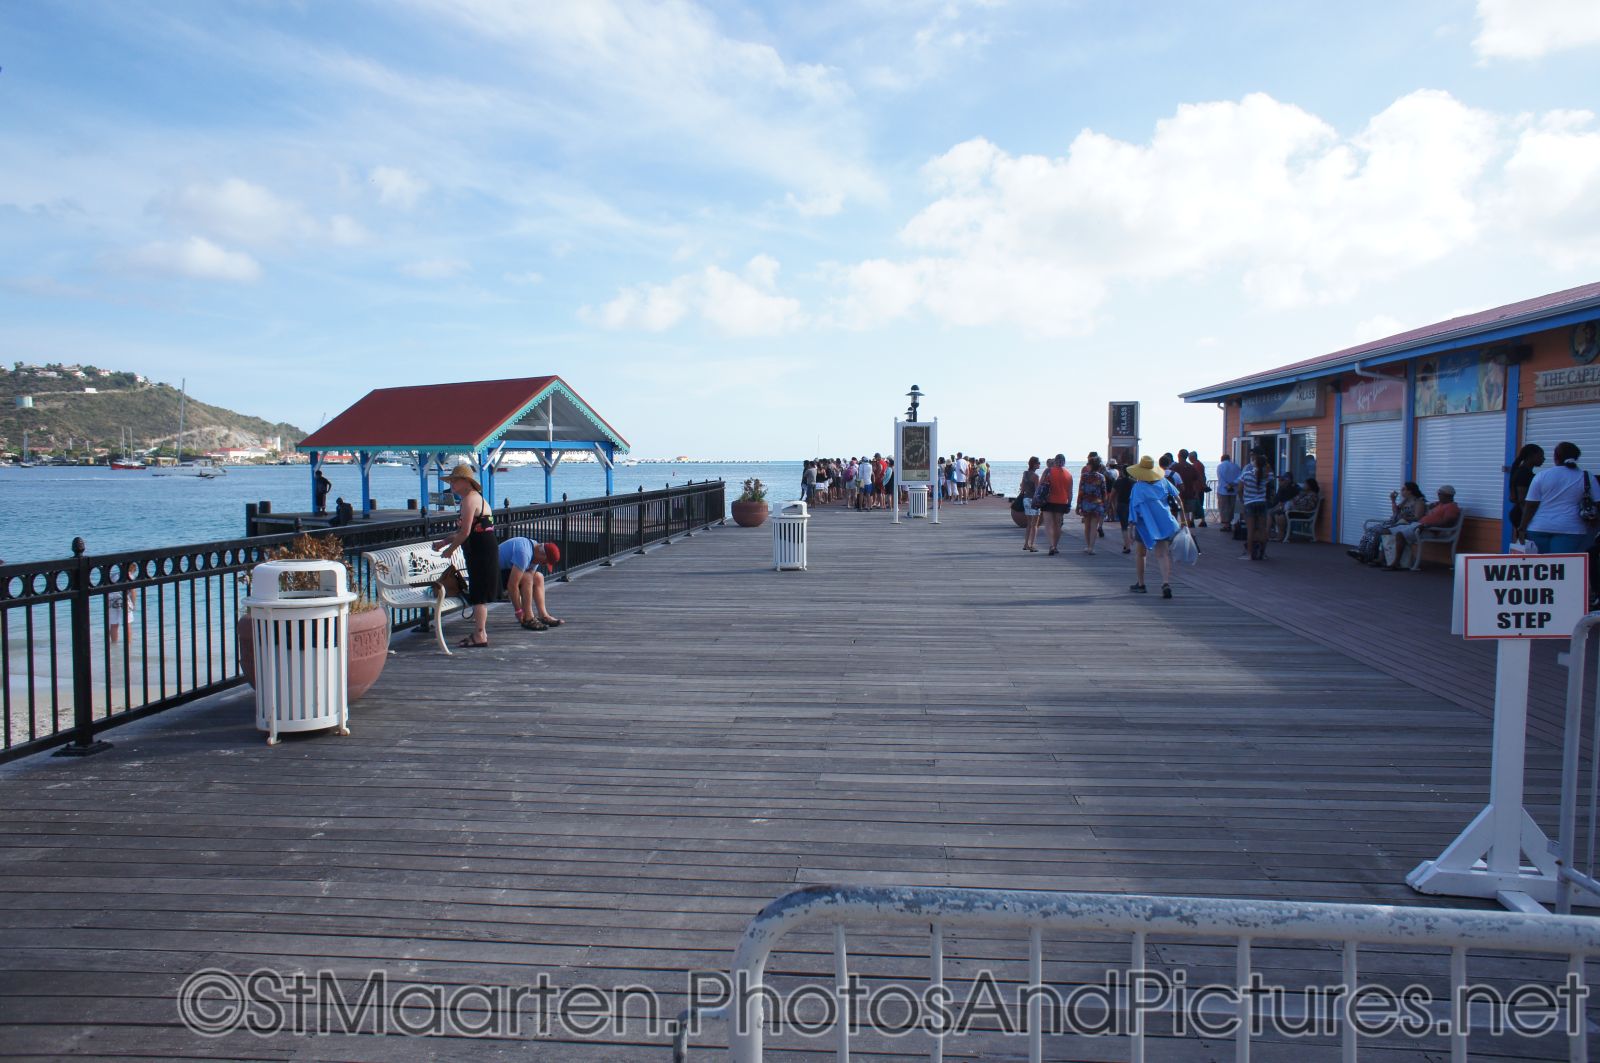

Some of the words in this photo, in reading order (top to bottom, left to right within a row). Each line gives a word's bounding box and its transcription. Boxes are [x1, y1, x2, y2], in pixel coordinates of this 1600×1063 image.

[1543, 372, 1566, 387] THE
[1483, 563, 1565, 582] WATCH
[1493, 588, 1554, 606] YOUR
[1497, 612, 1552, 629] STEP
